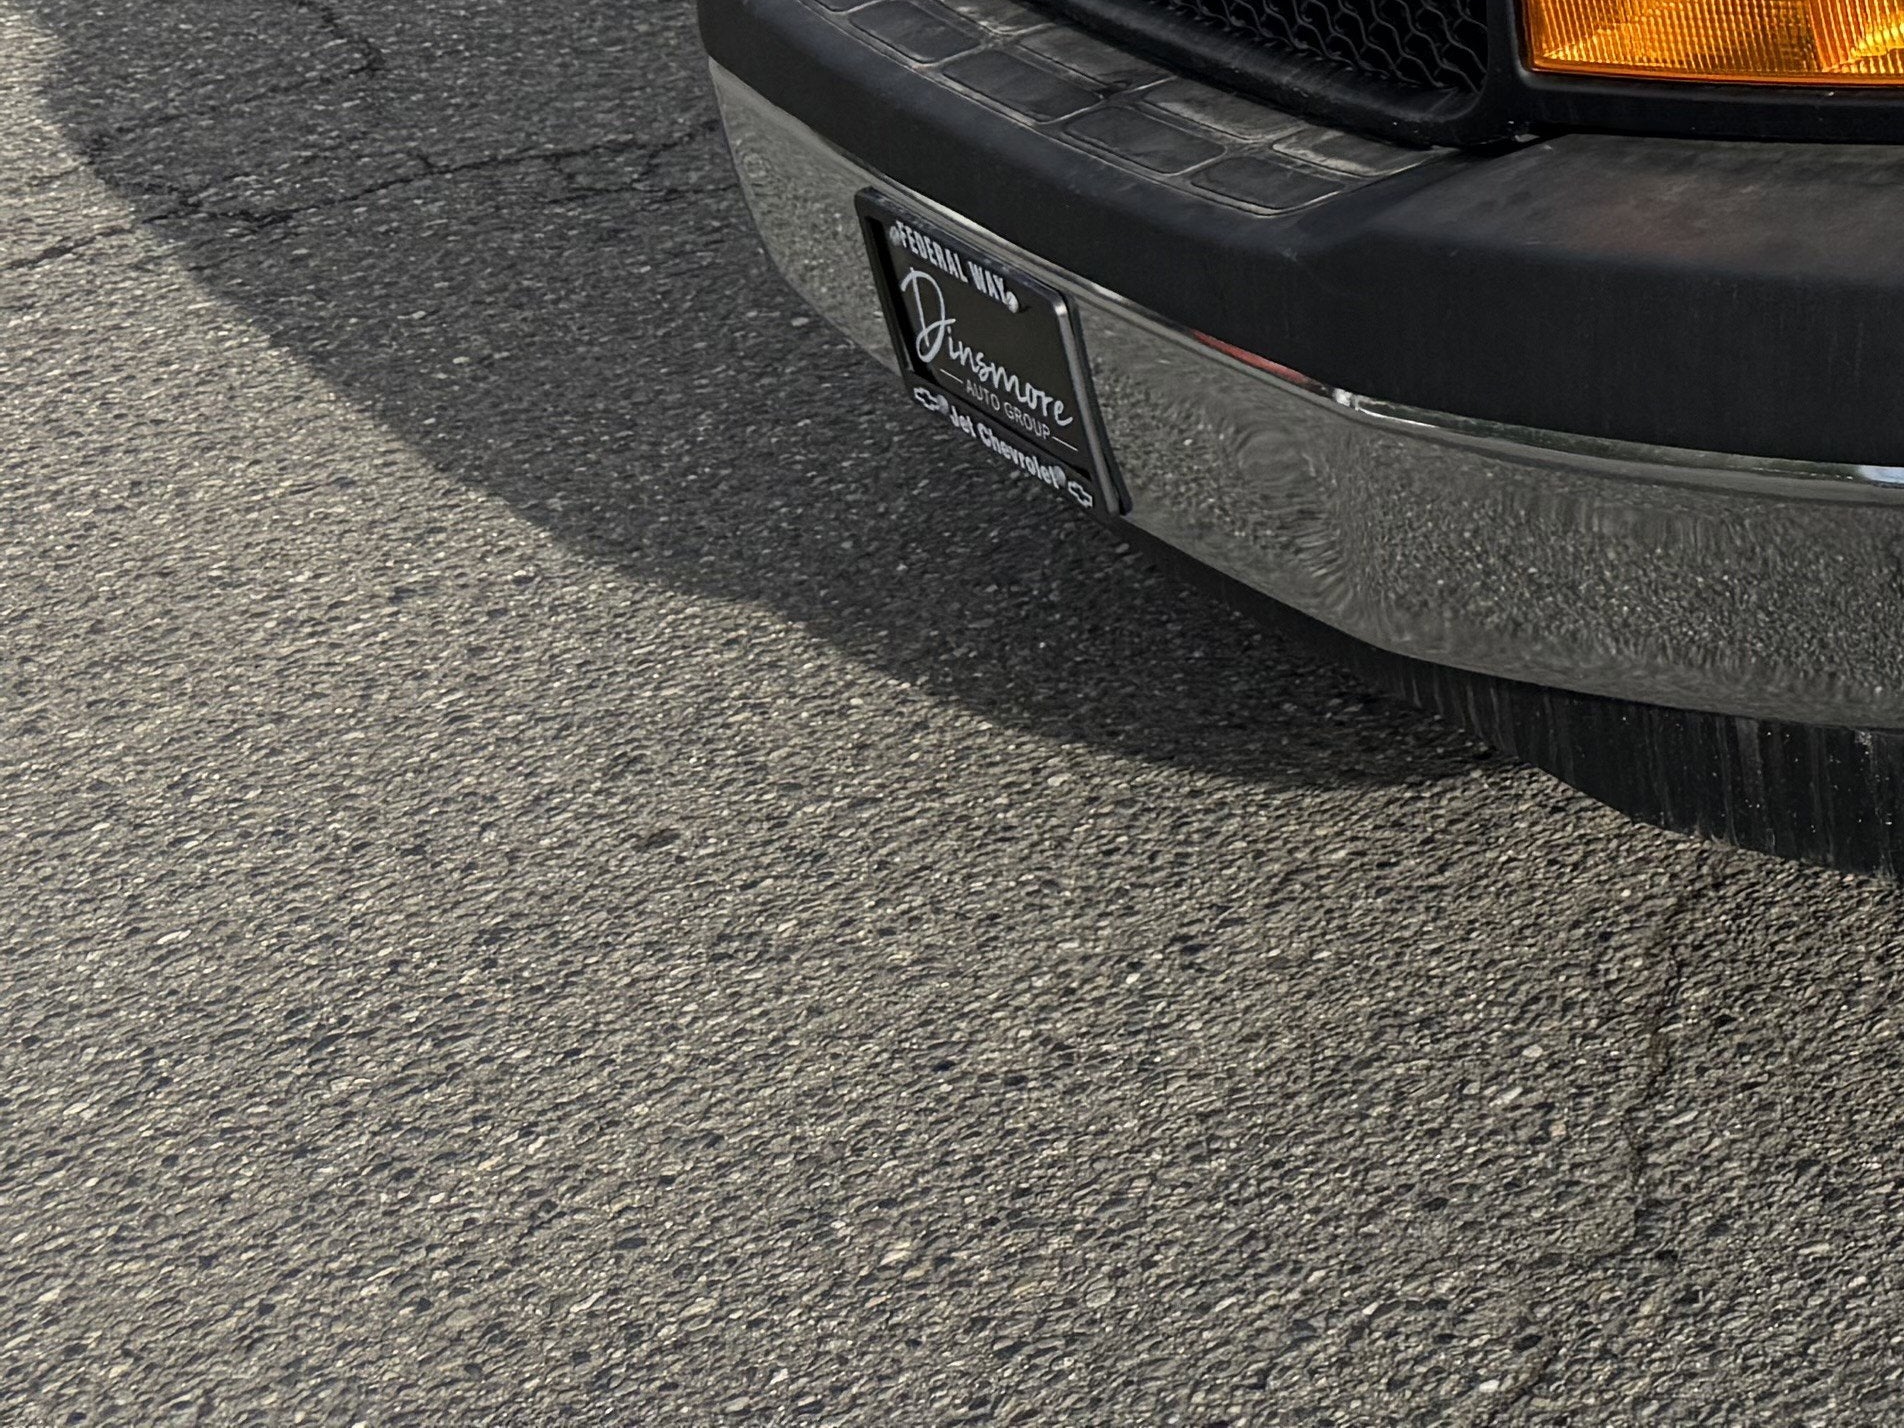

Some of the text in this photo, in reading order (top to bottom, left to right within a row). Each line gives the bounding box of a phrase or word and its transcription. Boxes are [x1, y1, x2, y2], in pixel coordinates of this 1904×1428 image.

[895, 219, 1008, 306] FEDERAL WAY
[900, 266, 1074, 427] Dinsmore
[949, 404, 1060, 490] Jet Chevrolet
[965, 379, 1051, 441] AUTO GROUP
